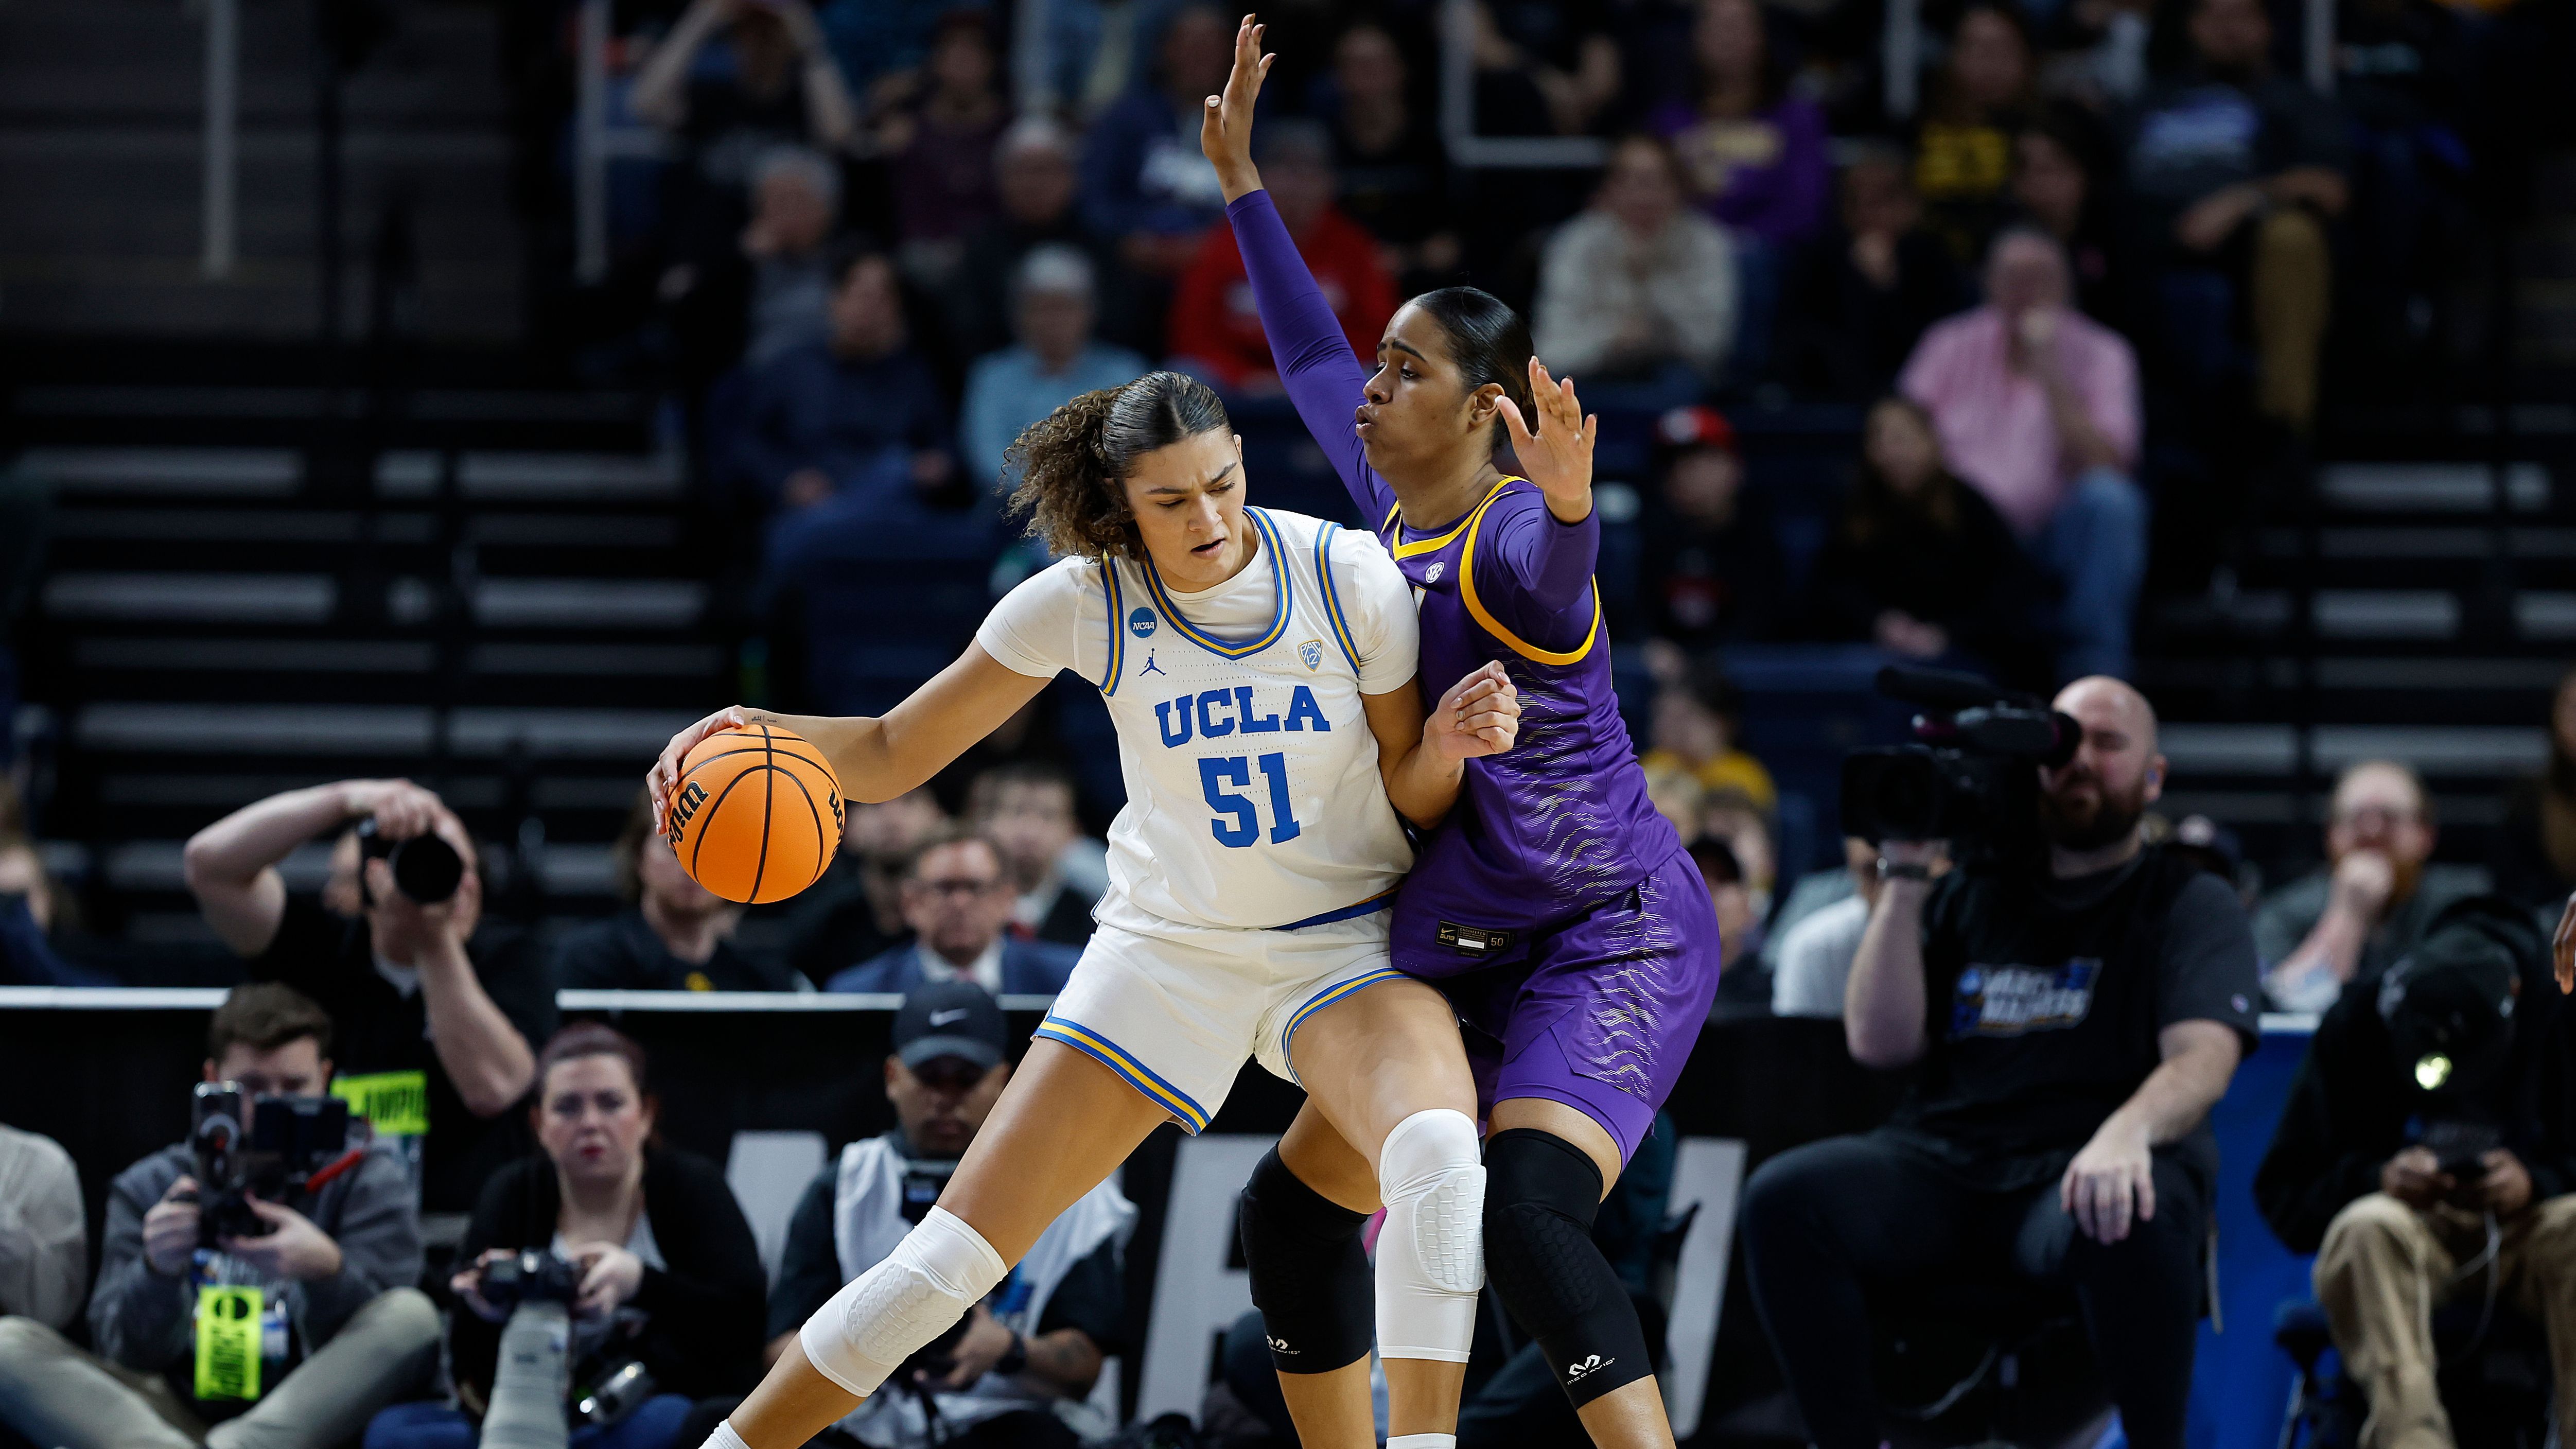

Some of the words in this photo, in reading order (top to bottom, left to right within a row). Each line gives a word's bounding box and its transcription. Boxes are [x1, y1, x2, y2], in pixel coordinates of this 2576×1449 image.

[1427, 563, 1443, 581] SEC
[1132, 621, 1155, 631] NCAA
[1300, 641, 1321, 661] PAC
[1306, 653, 1319, 666] 12
[1154, 685, 1331, 748] UCLA
[1197, 752, 1301, 848] 51
[1491, 937, 1503, 946] 50
